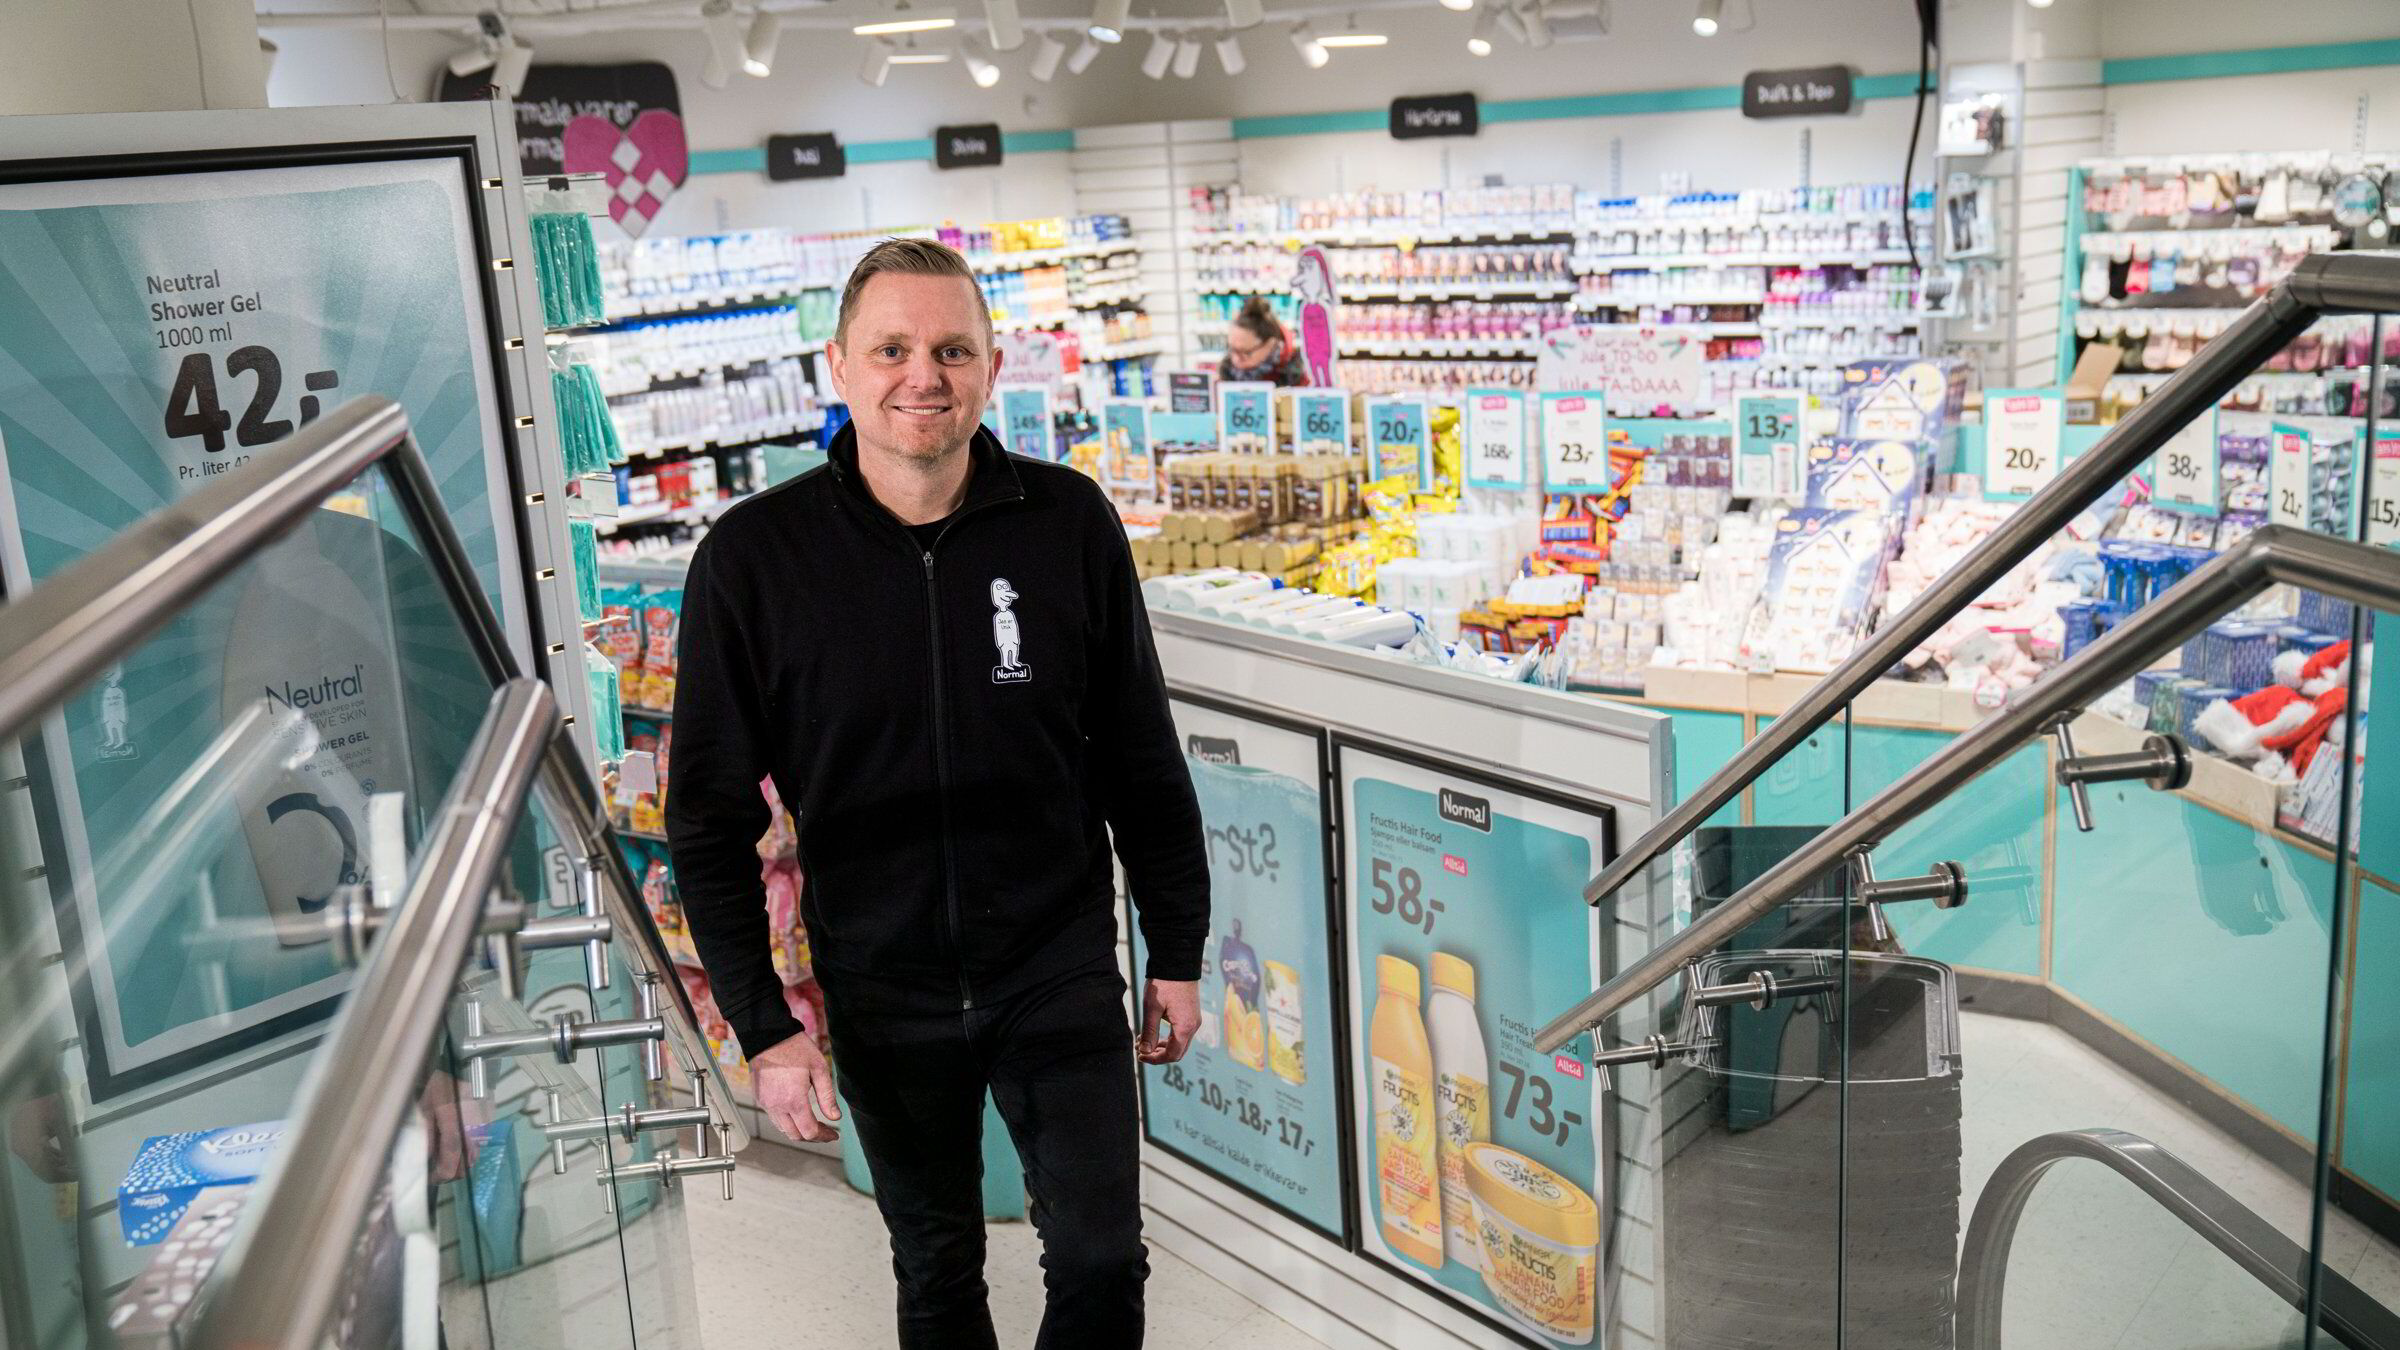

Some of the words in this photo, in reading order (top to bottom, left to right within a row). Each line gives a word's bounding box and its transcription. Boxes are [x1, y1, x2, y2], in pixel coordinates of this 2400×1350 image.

[147, 269, 220, 294] Neutral
[151, 300, 225, 322] Shower
[231, 292, 262, 313] Gel
[157, 326, 204, 349] 1000
[209, 321, 233, 342] ml
[1598, 376, 1682, 394] TA-DAAA
[1232, 407, 1265, 429] 66,-
[1307, 412, 1340, 435] 66,-
[1748, 414, 1794, 440] 13,-
[1380, 420, 1419, 443] 20,-
[1560, 443, 1593, 464] 23,-
[2005, 447, 2046, 471] 20,-
[179, 464, 200, 480] Pr.
[202, 458, 231, 476] liter
[2168, 453, 2202, 481] 38,-
[997, 668, 1027, 680] Normal
[265, 664, 363, 715] Neutral
[340, 708, 368, 726] SKIN
[348, 730, 370, 745] GEL
[1443, 792, 1486, 824] Normal
[1370, 812, 1399, 831] Fructis
[1400, 821, 1418, 836] Hair
[1420, 828, 1442, 844] Food
[1206, 822, 1279, 883] rst?
[1372, 856, 1445, 935] 58,-
[1500, 1014, 1529, 1036] Fructis
[1557, 1059, 1583, 1077] Alltid
[1382, 1080, 1420, 1107] FRUCTIS
[1437, 1084, 1477, 1113] FRUCTIS
[1499, 1060, 1582, 1147] 73,-
[1198, 1077, 1233, 1116] 10,-
[1237, 1096, 1272, 1136] 18,-
[1278, 1116, 1315, 1158] 17,-
[1508, 1243, 1556, 1281] FRUCTIS
[1510, 1262, 1558, 1297] BANANA
[1532, 1288, 1565, 1310] FOOD
